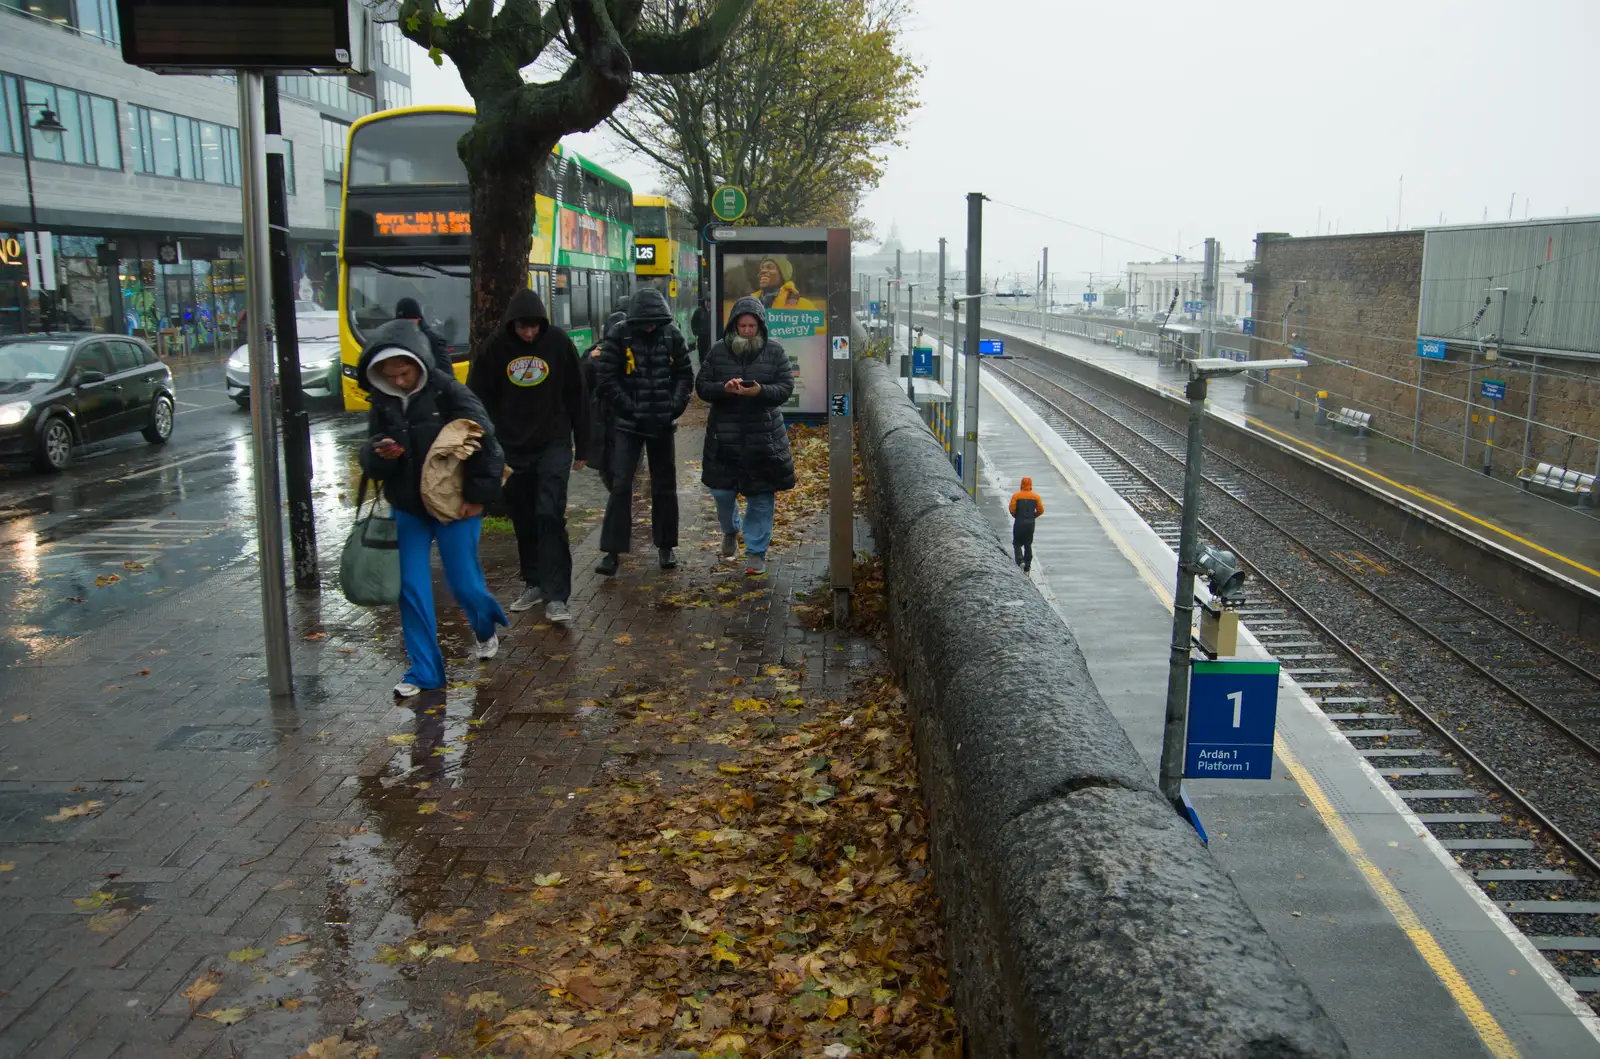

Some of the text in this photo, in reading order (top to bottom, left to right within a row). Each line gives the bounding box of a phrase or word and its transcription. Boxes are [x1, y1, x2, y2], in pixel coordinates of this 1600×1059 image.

[636, 247, 653, 259] L25
[768, 312, 820, 325] bring the
[770, 325, 810, 336] energy
[920, 353, 925, 364] 1
[1227, 691, 1242, 728] 1
[1199, 749, 1238, 759] Ardán 1
[1198, 761, 1250, 771] Platform 1
